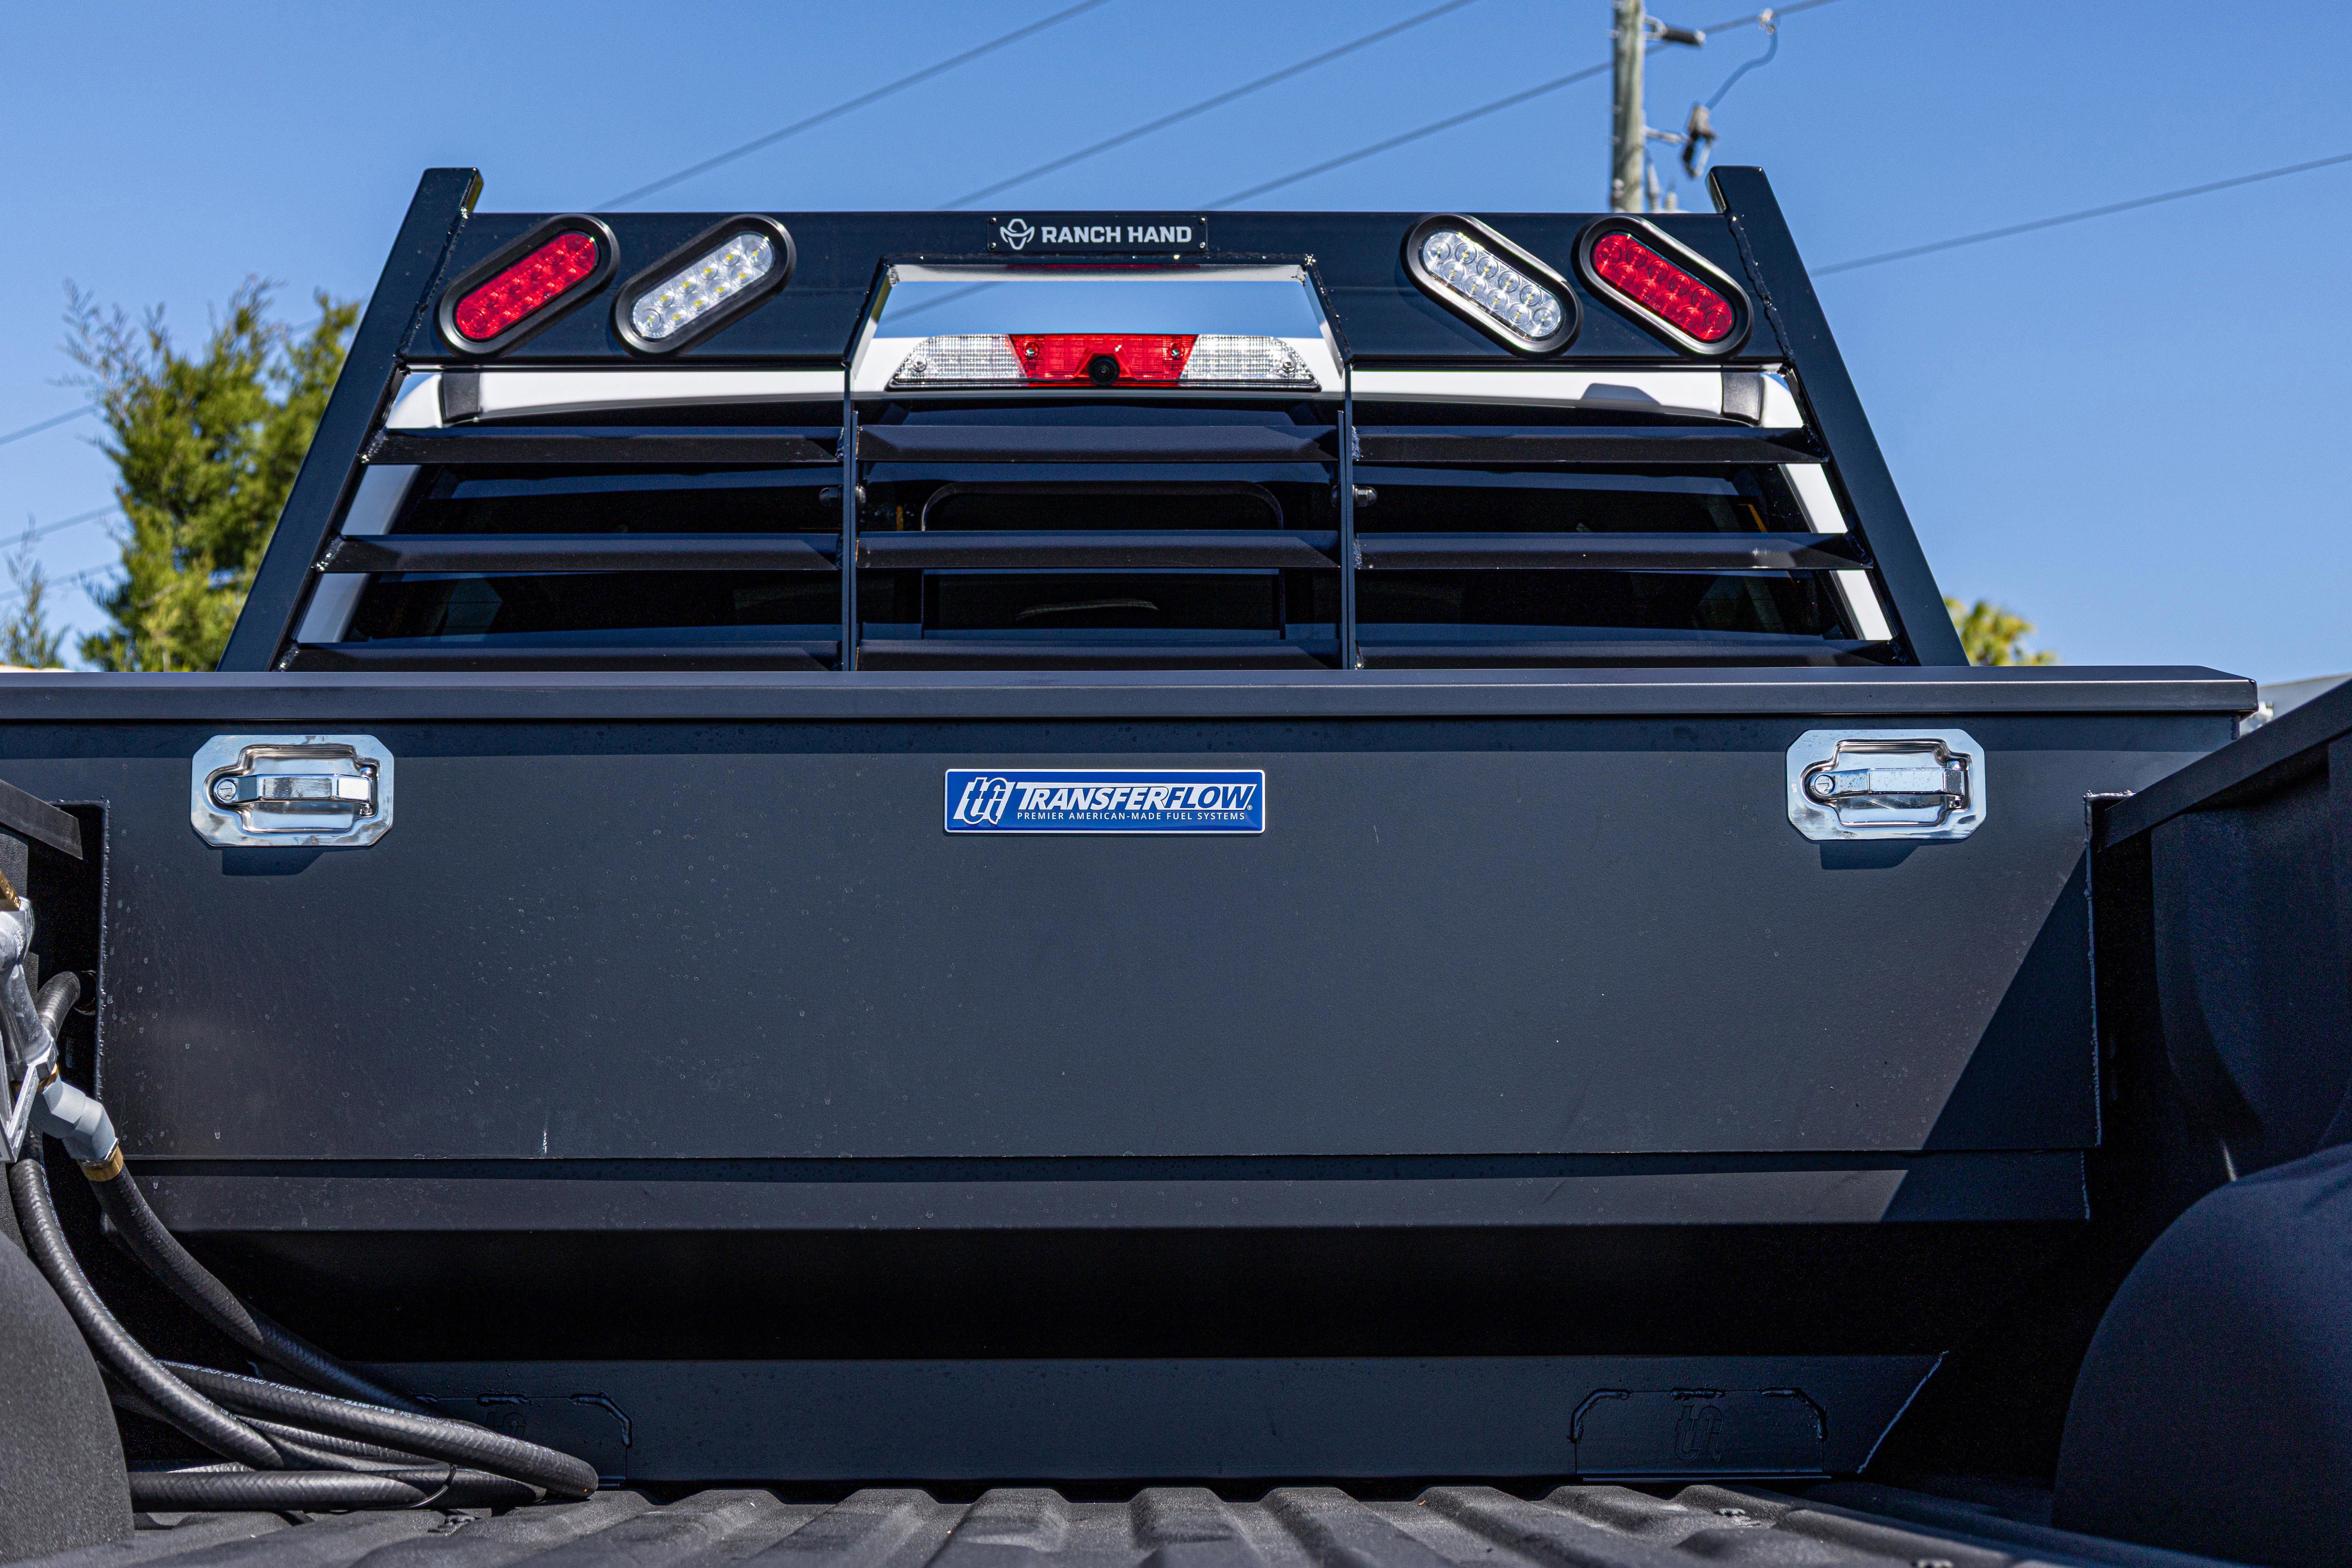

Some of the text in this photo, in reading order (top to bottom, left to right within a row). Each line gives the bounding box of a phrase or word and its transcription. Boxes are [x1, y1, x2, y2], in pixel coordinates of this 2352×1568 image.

[1041, 226, 1192, 243] RANCH HAND
[1015, 782, 1257, 811] TRANSFERFLOW
[1197, 812, 1245, 820] SYSTEMS
[416, 1414, 474, 1432] STATIC-WIRE
